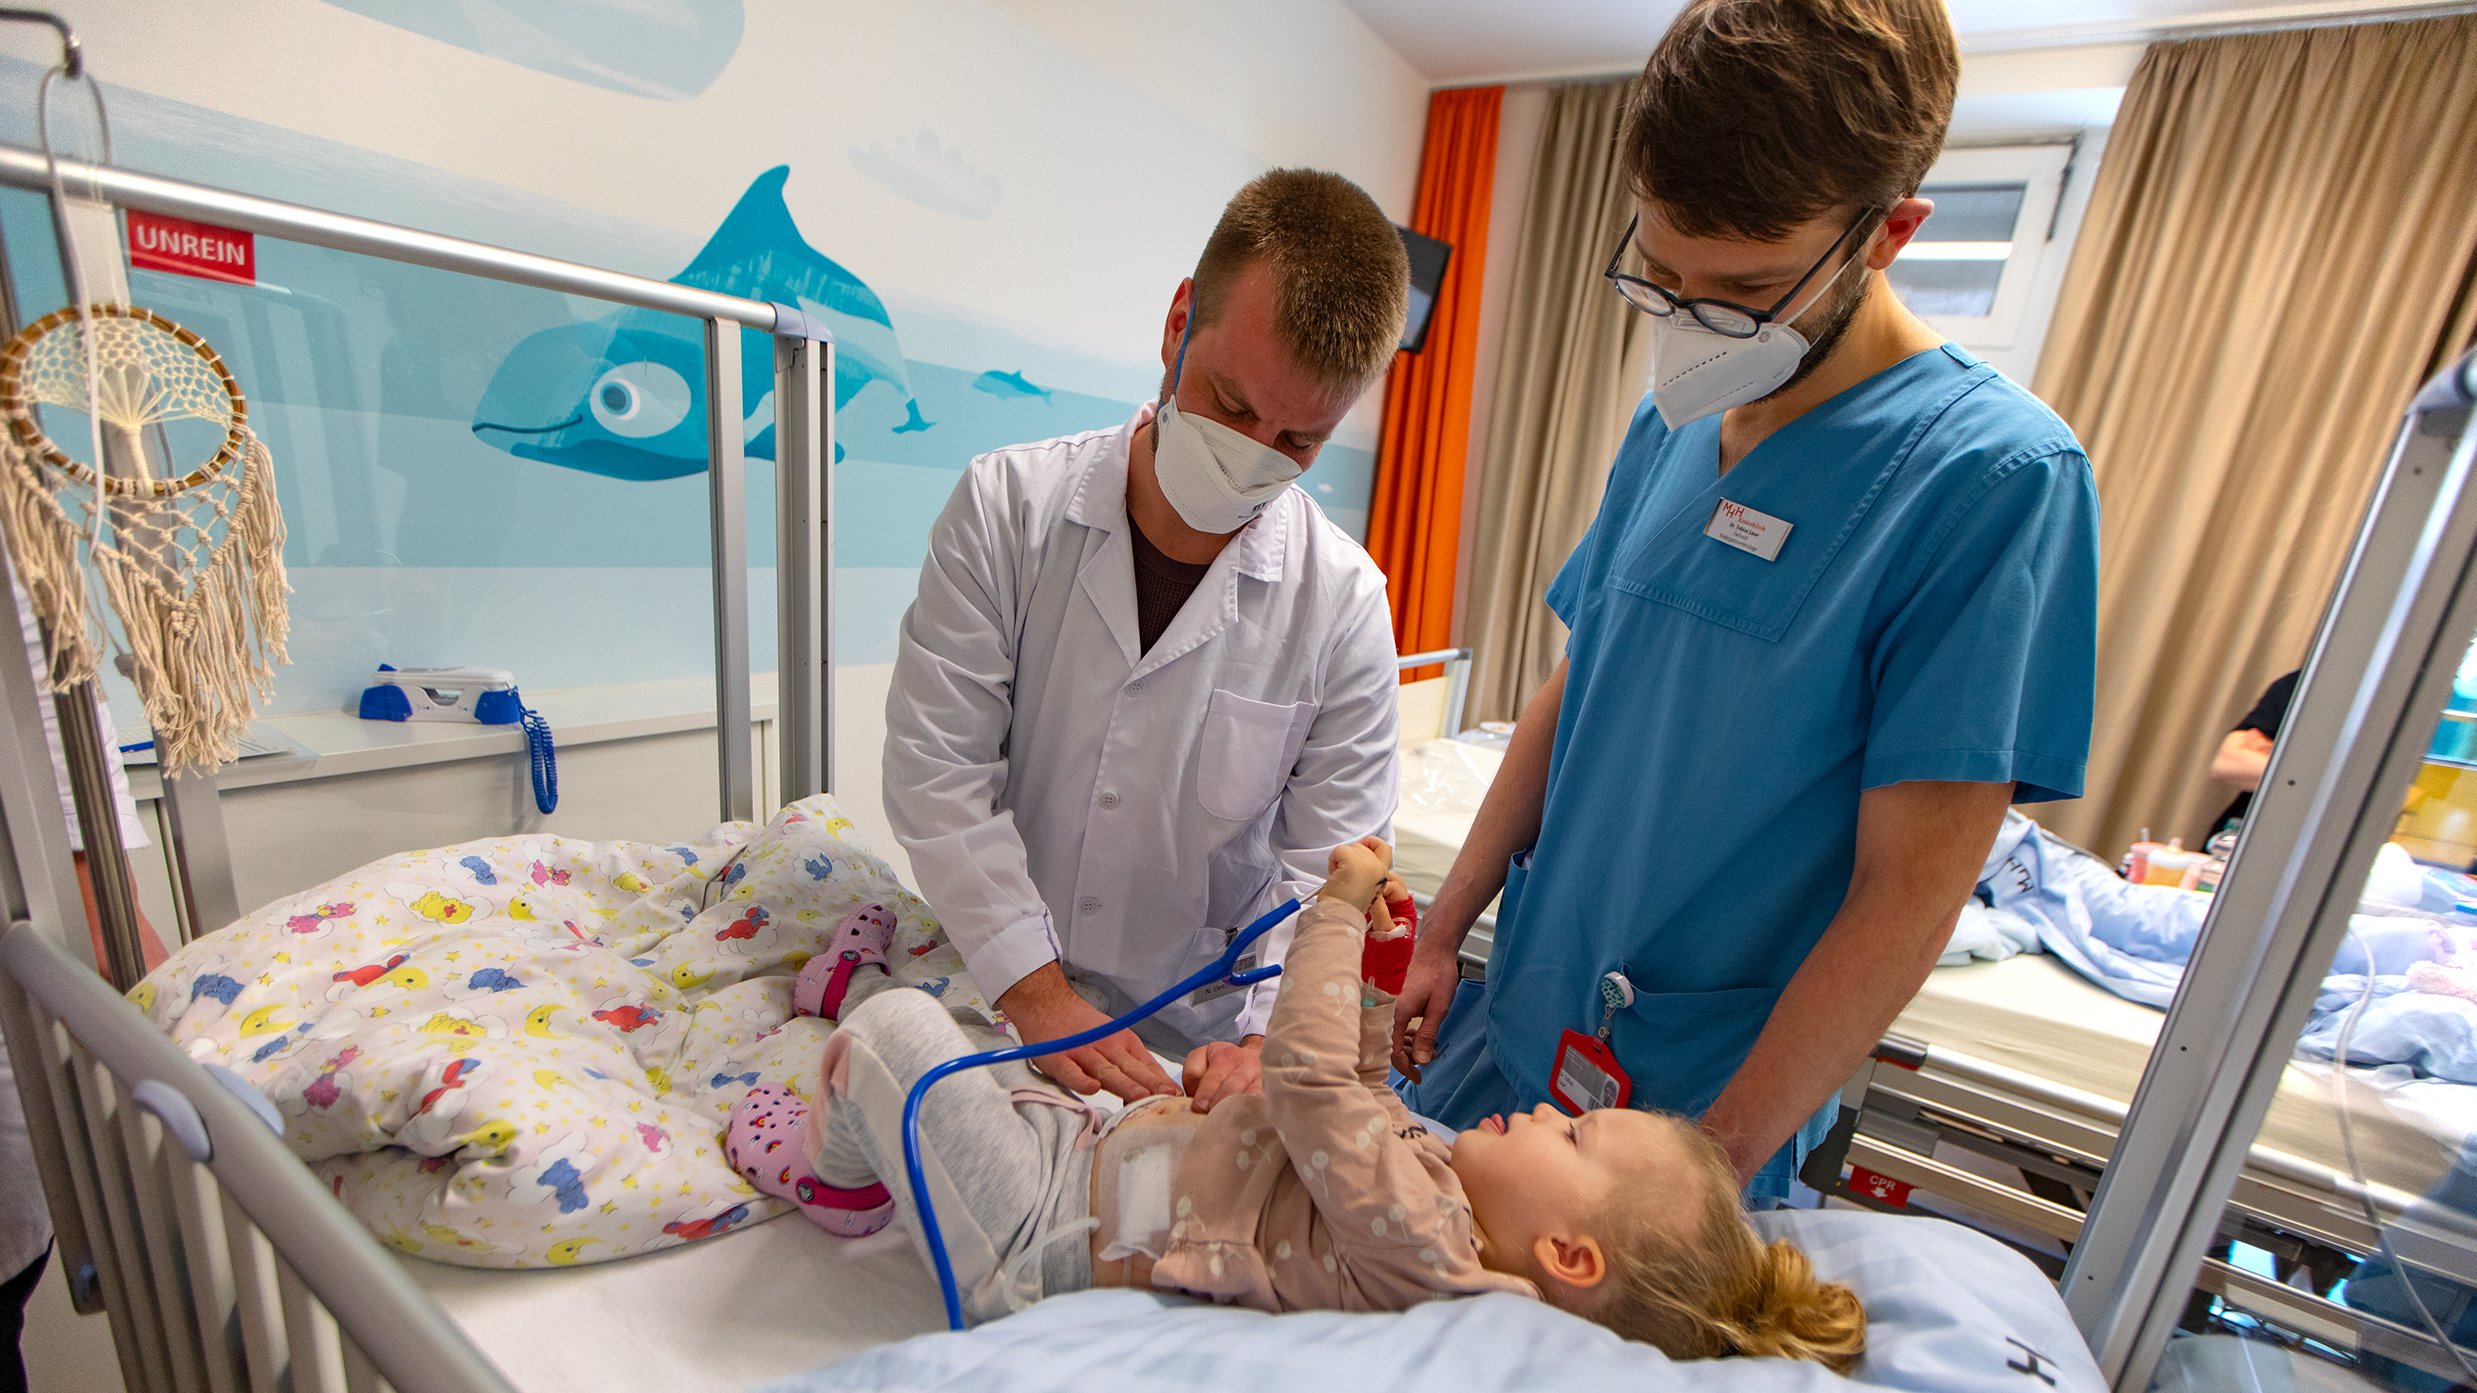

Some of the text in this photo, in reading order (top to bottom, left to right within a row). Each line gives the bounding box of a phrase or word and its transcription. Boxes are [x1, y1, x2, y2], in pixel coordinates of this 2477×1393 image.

[136, 225, 246, 266] UNREIN
[1723, 502, 1745, 518] MHH
[1869, 1175, 1896, 1191] CPR
